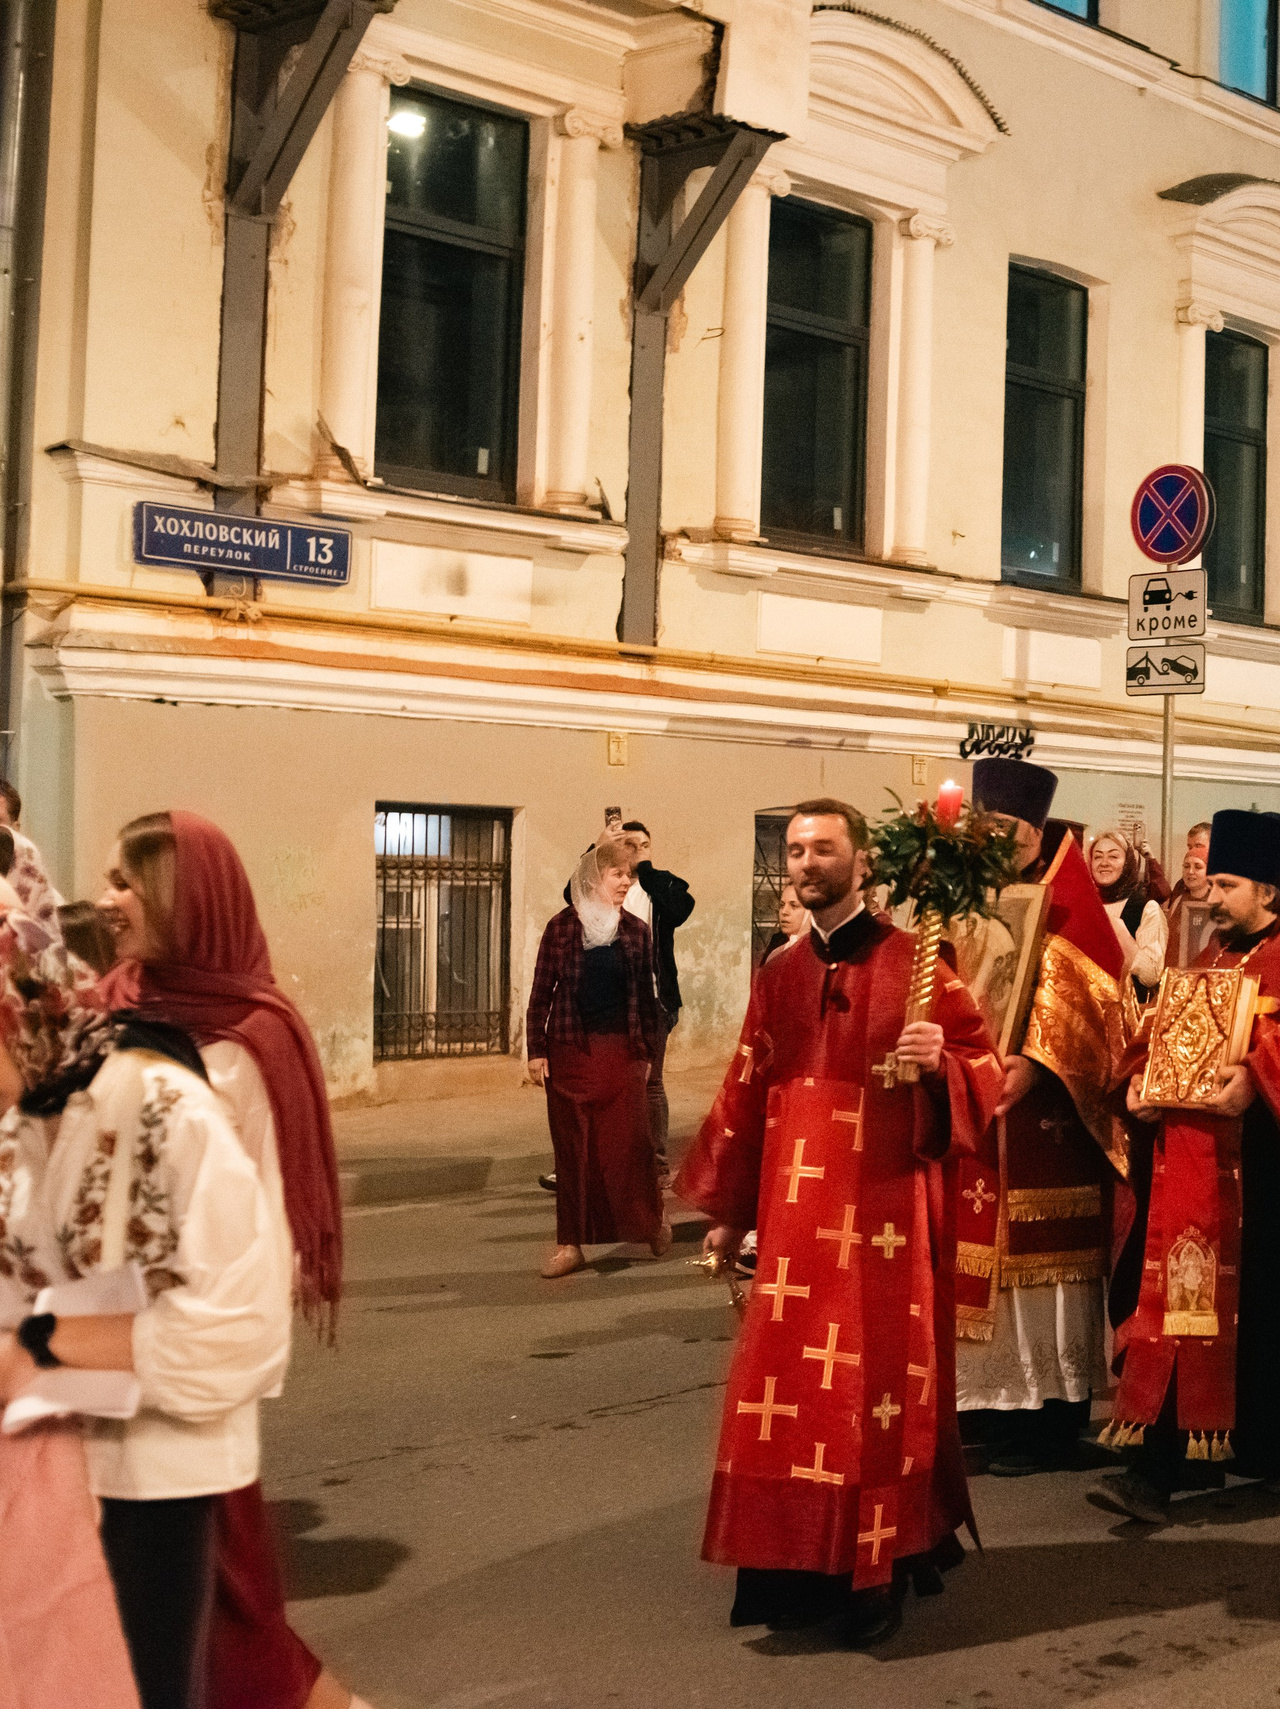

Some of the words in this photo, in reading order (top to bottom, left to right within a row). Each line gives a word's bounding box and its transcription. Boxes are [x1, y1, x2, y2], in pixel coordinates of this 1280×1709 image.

[153, 515, 280, 549] ХОХЛОВСКИЙ
[183, 543, 251, 561] ПЕРЕУЛОК
[306, 536, 334, 564] 13
[293, 564, 337, 576] СТРОЕНИЕ
[1136, 614, 1198, 636] кроме
